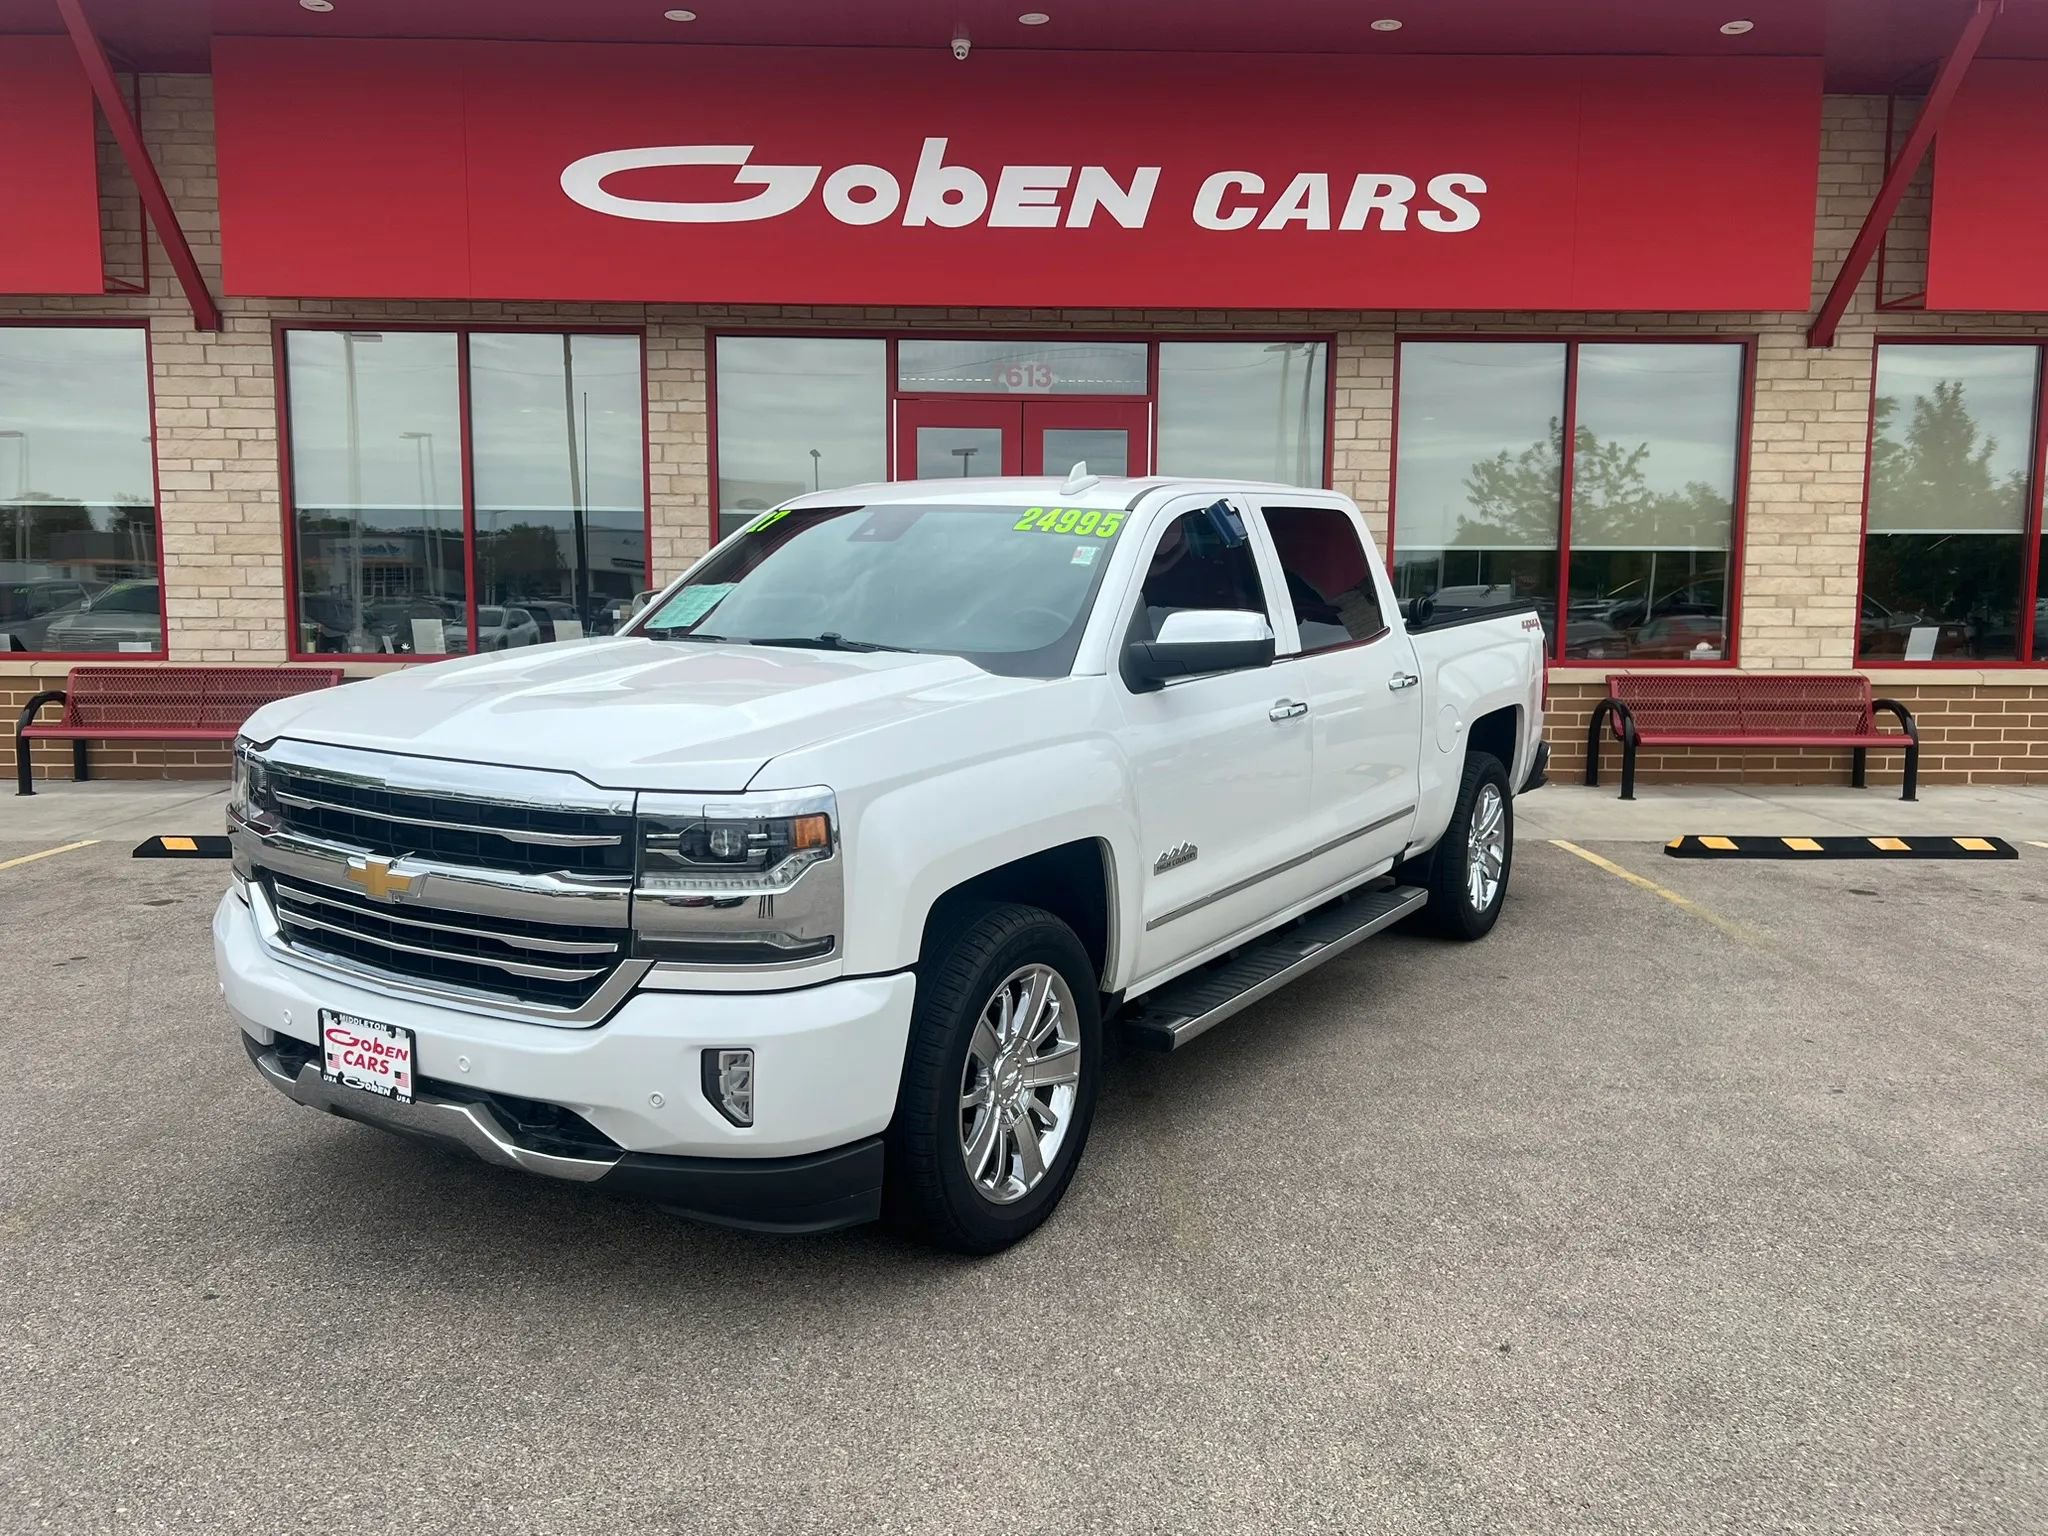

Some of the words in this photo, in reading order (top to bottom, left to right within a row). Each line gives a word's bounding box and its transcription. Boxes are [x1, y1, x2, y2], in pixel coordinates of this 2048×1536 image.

[1192, 170, 1488, 233] CARS
[1012, 507, 1126, 538] 24995
[339, 1013, 387, 1031] MIDDLETON
[343, 1050, 390, 1075] CARS
[323, 1074, 337, 1084] USA
[396, 1094, 411, 1104] USA
